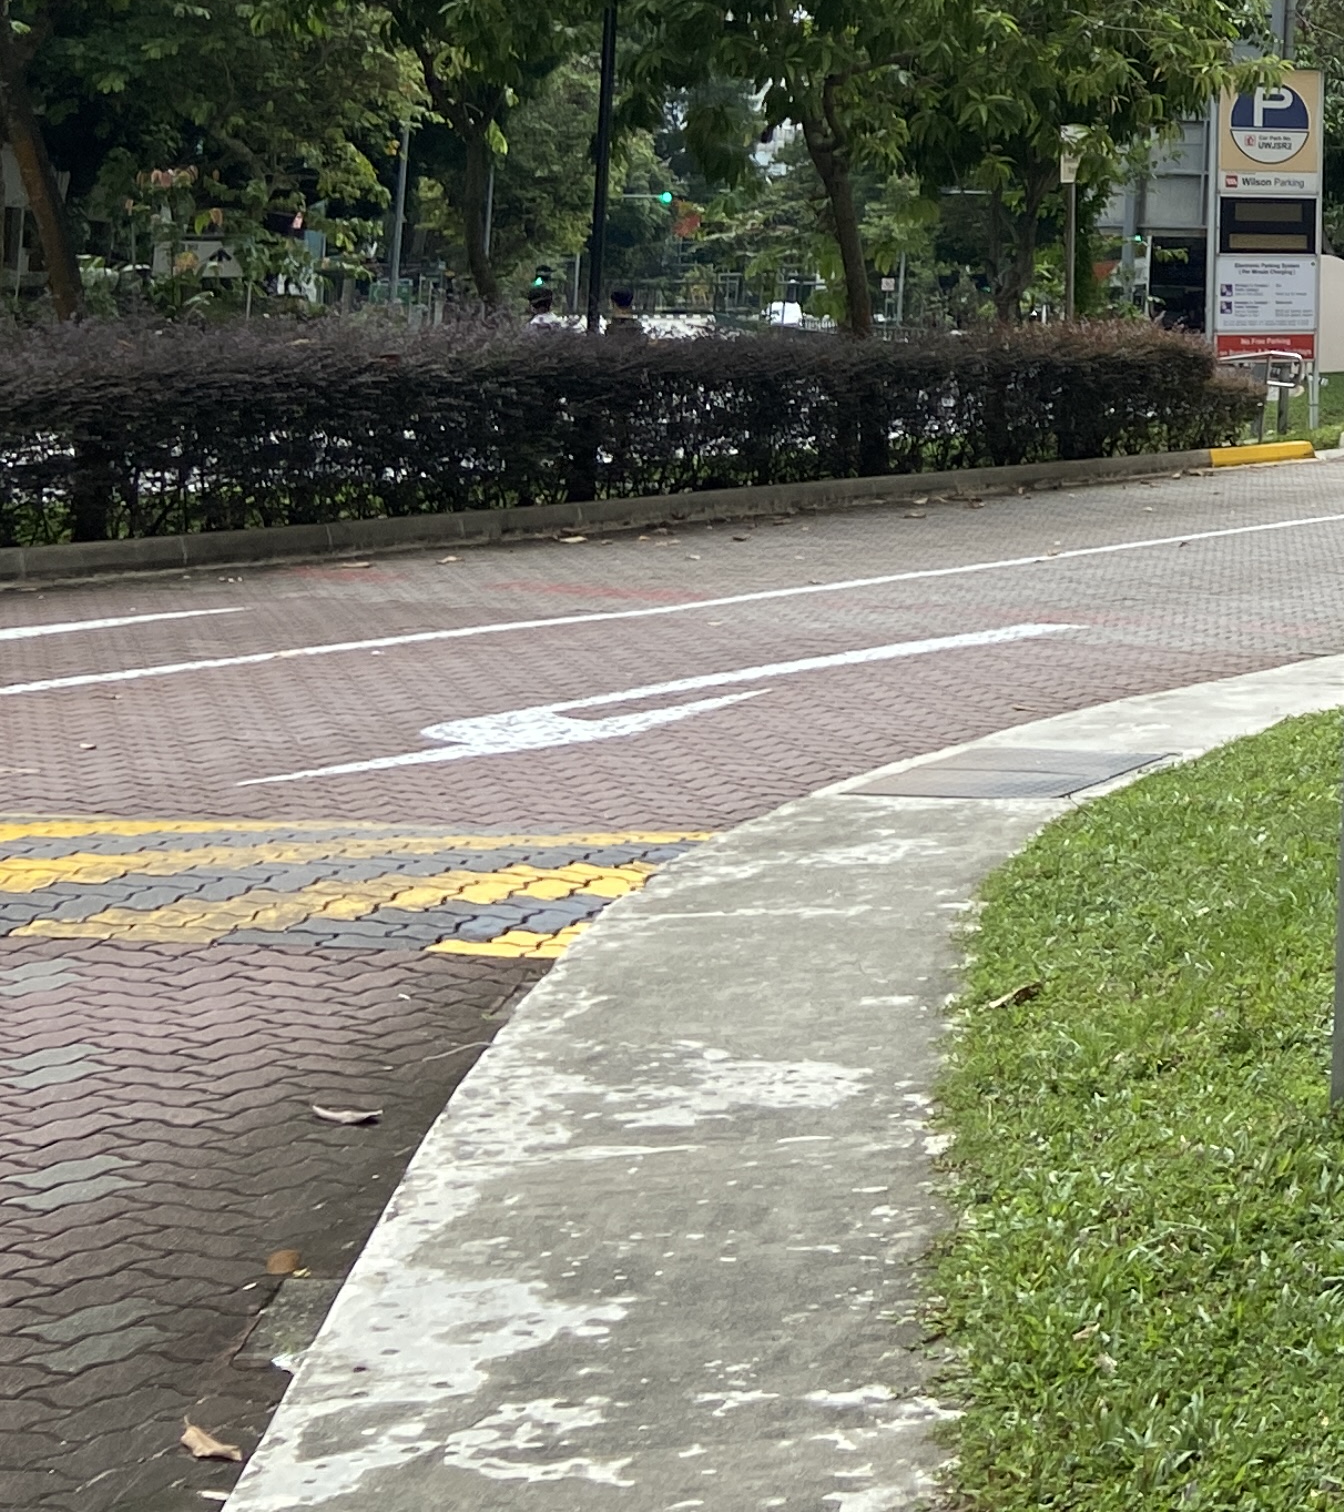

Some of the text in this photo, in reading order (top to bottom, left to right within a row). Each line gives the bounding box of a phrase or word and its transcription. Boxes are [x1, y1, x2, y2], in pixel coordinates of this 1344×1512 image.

[1253, 86, 1294, 127] P
[1242, 178, 1304, 189] Wilson Parking
[1266, 338, 1291, 346] Parking
